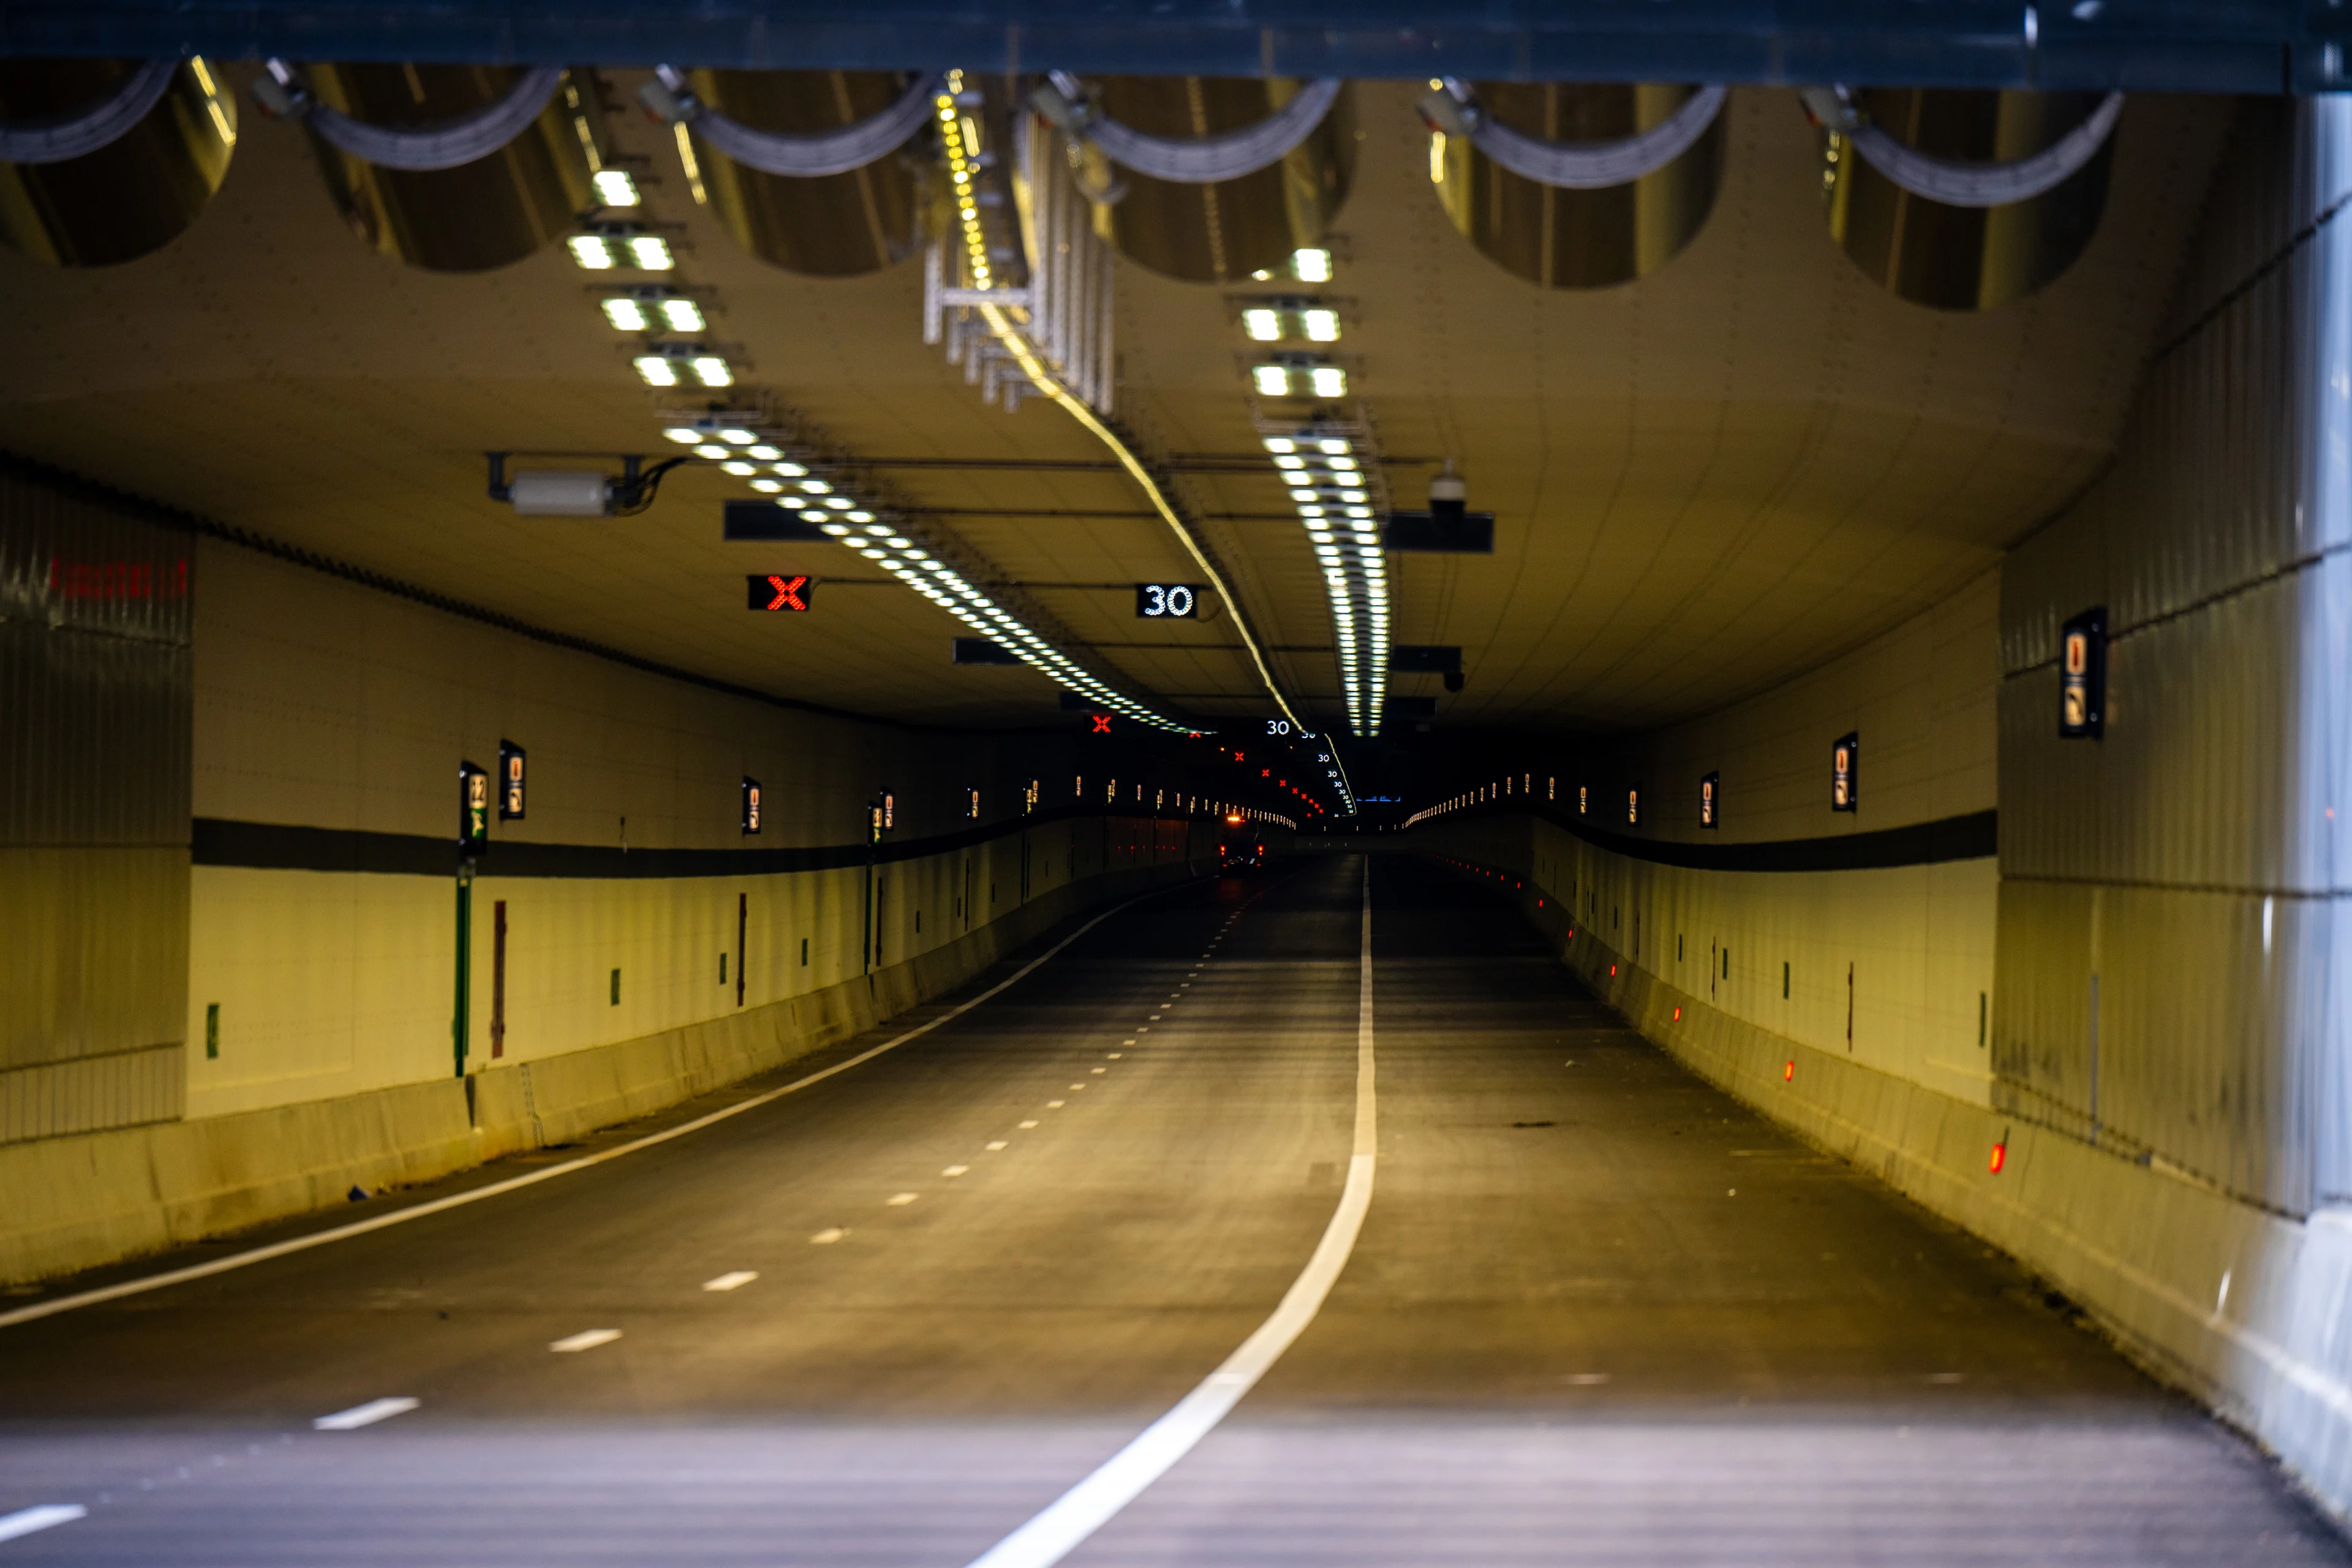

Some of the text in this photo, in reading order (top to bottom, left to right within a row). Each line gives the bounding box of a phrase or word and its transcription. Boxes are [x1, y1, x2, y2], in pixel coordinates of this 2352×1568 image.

[1145, 585, 1193, 616] 30
[1267, 720, 1290, 735] 30
[1318, 754, 1330, 763] 30
